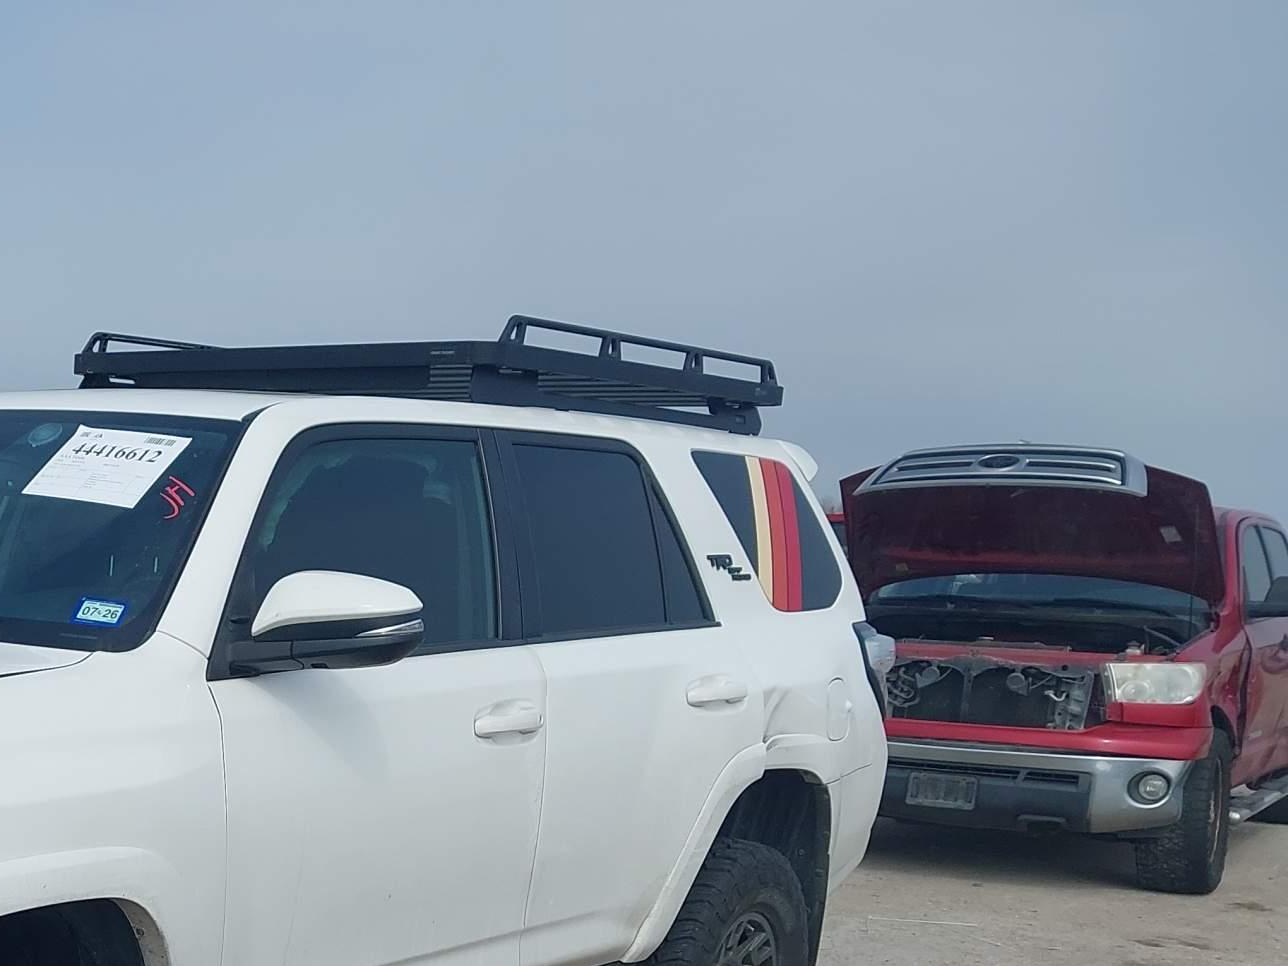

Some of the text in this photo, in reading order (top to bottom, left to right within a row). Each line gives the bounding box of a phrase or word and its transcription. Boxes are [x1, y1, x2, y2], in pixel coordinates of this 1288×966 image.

[72, 442, 163, 463] 44416612
[82, 606, 120, 619] 07 26
